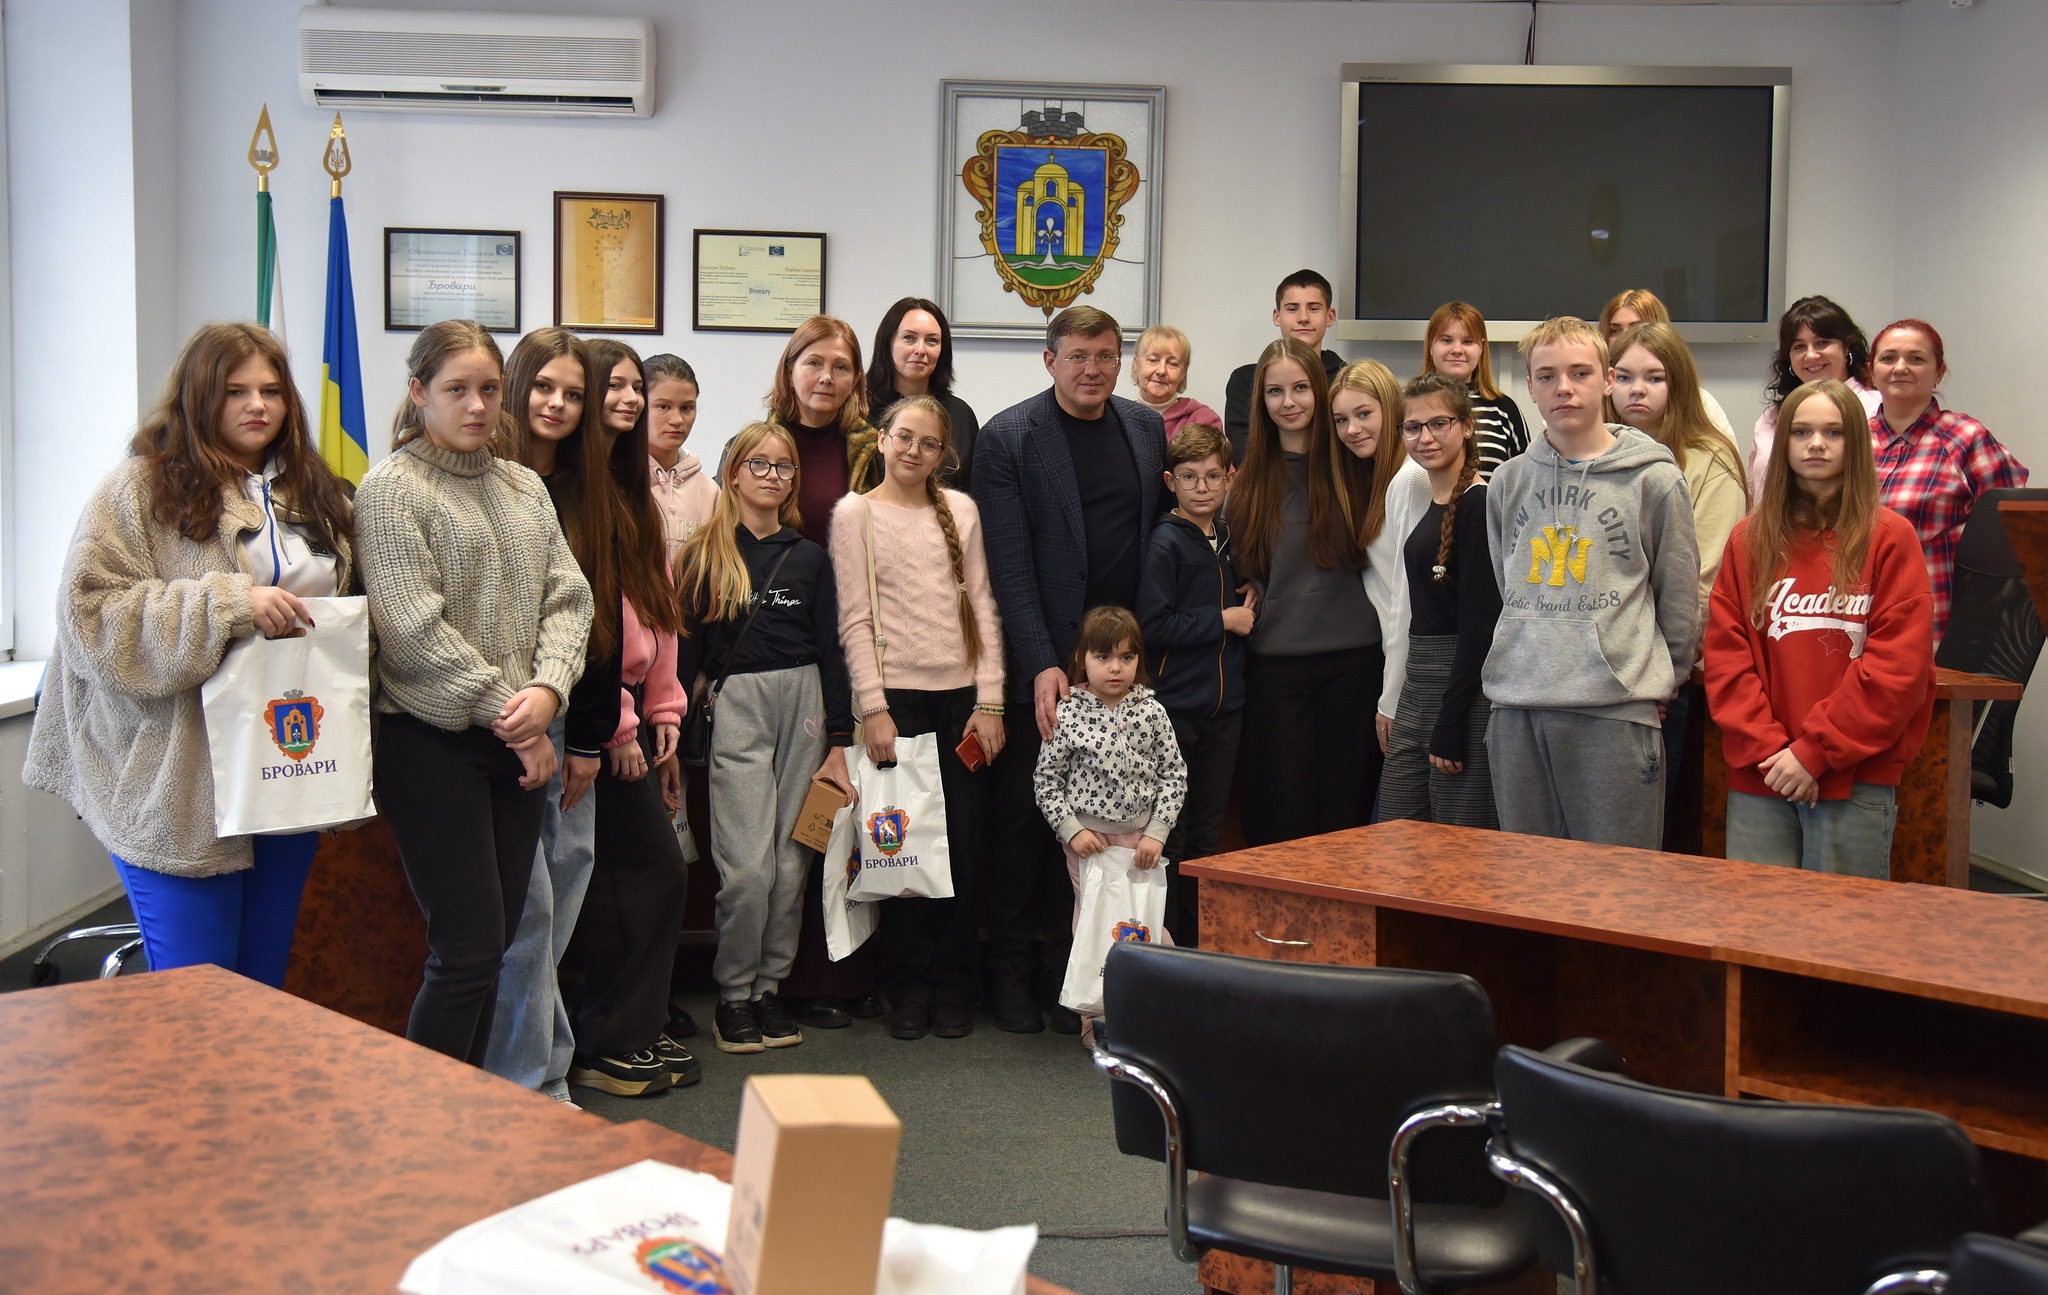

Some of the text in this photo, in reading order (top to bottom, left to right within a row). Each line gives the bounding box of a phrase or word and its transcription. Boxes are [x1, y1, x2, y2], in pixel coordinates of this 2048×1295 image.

[427, 280, 477, 292] Бровари
[1535, 485, 1597, 511] YORK
[1597, 507, 1630, 561] CITY
[1535, 595, 1570, 612] Brand
[1765, 577, 1875, 622] Academ
[261, 759, 338, 781] БРОВАРИ
[865, 855, 919, 870] БРОВАРИ
